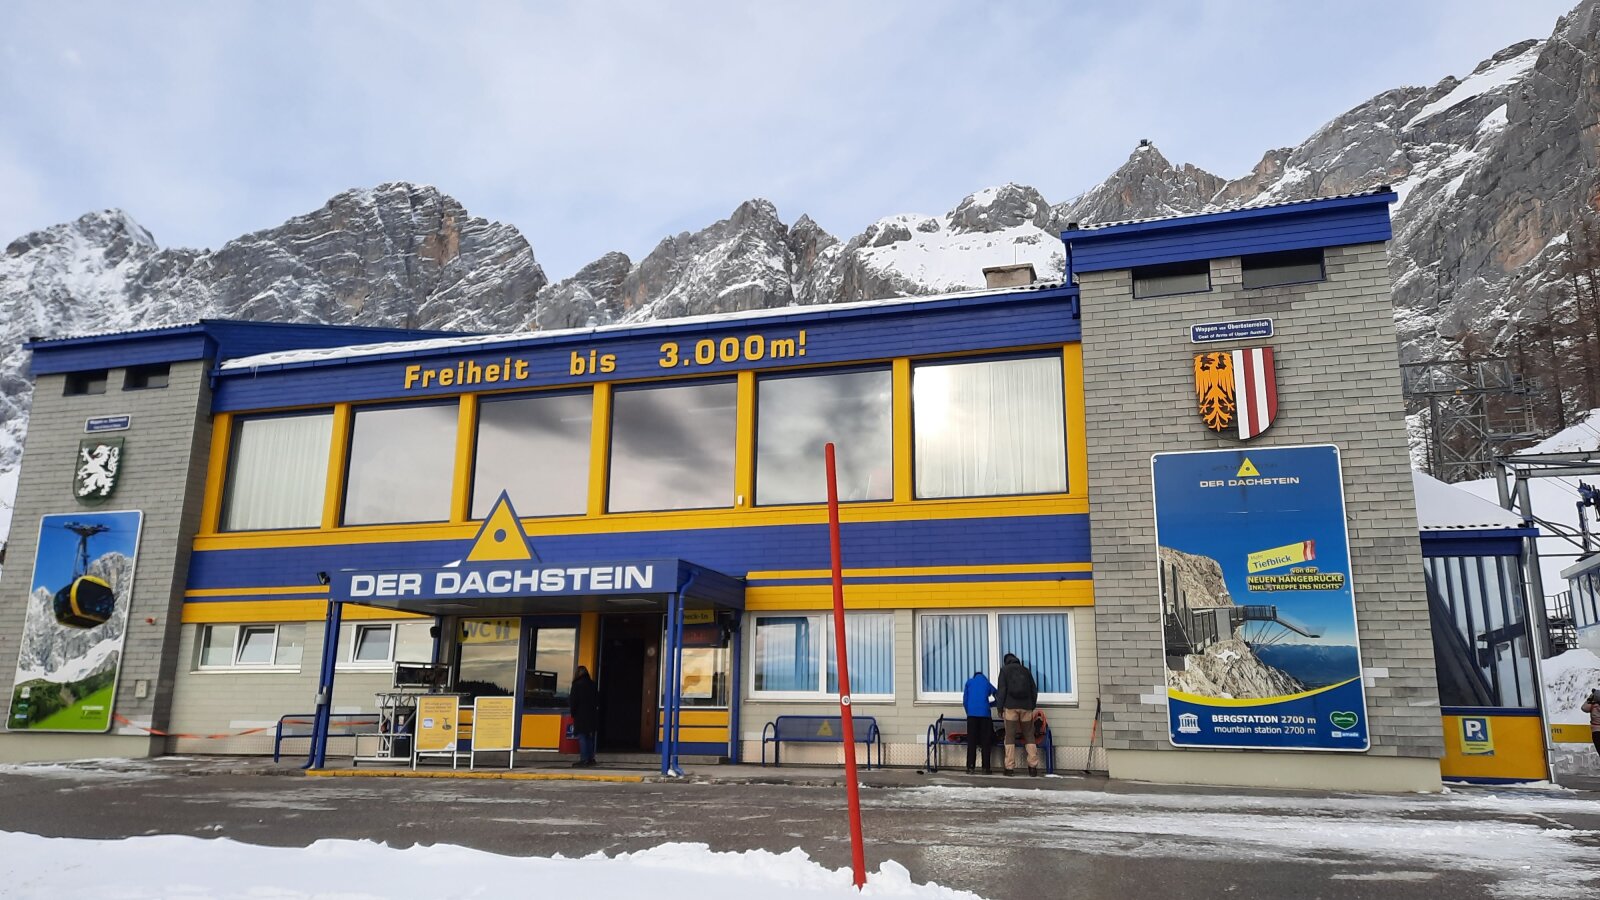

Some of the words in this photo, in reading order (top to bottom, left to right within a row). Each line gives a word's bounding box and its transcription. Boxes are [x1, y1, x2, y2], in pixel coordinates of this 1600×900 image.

[404, 358, 529, 389] Freiheit
[569, 350, 617, 376] bis
[659, 330, 807, 369] 3.000m!
[1228, 477, 1300, 487] DACHSTEIN
[1253, 555, 1292, 569] Tiefblick
[350, 574, 422, 597] DER
[434, 565, 653, 595] DACHSTEIN
[463, 621, 491, 638] WC
[1211, 714, 1278, 724] BERGSTATION
[1280, 716, 1304, 724] 2700
[1214, 726, 1252, 734] mountain
[1254, 726, 1282, 734] station
[1284, 727, 1304, 735] 2700
[1465, 720, 1481, 737] P
